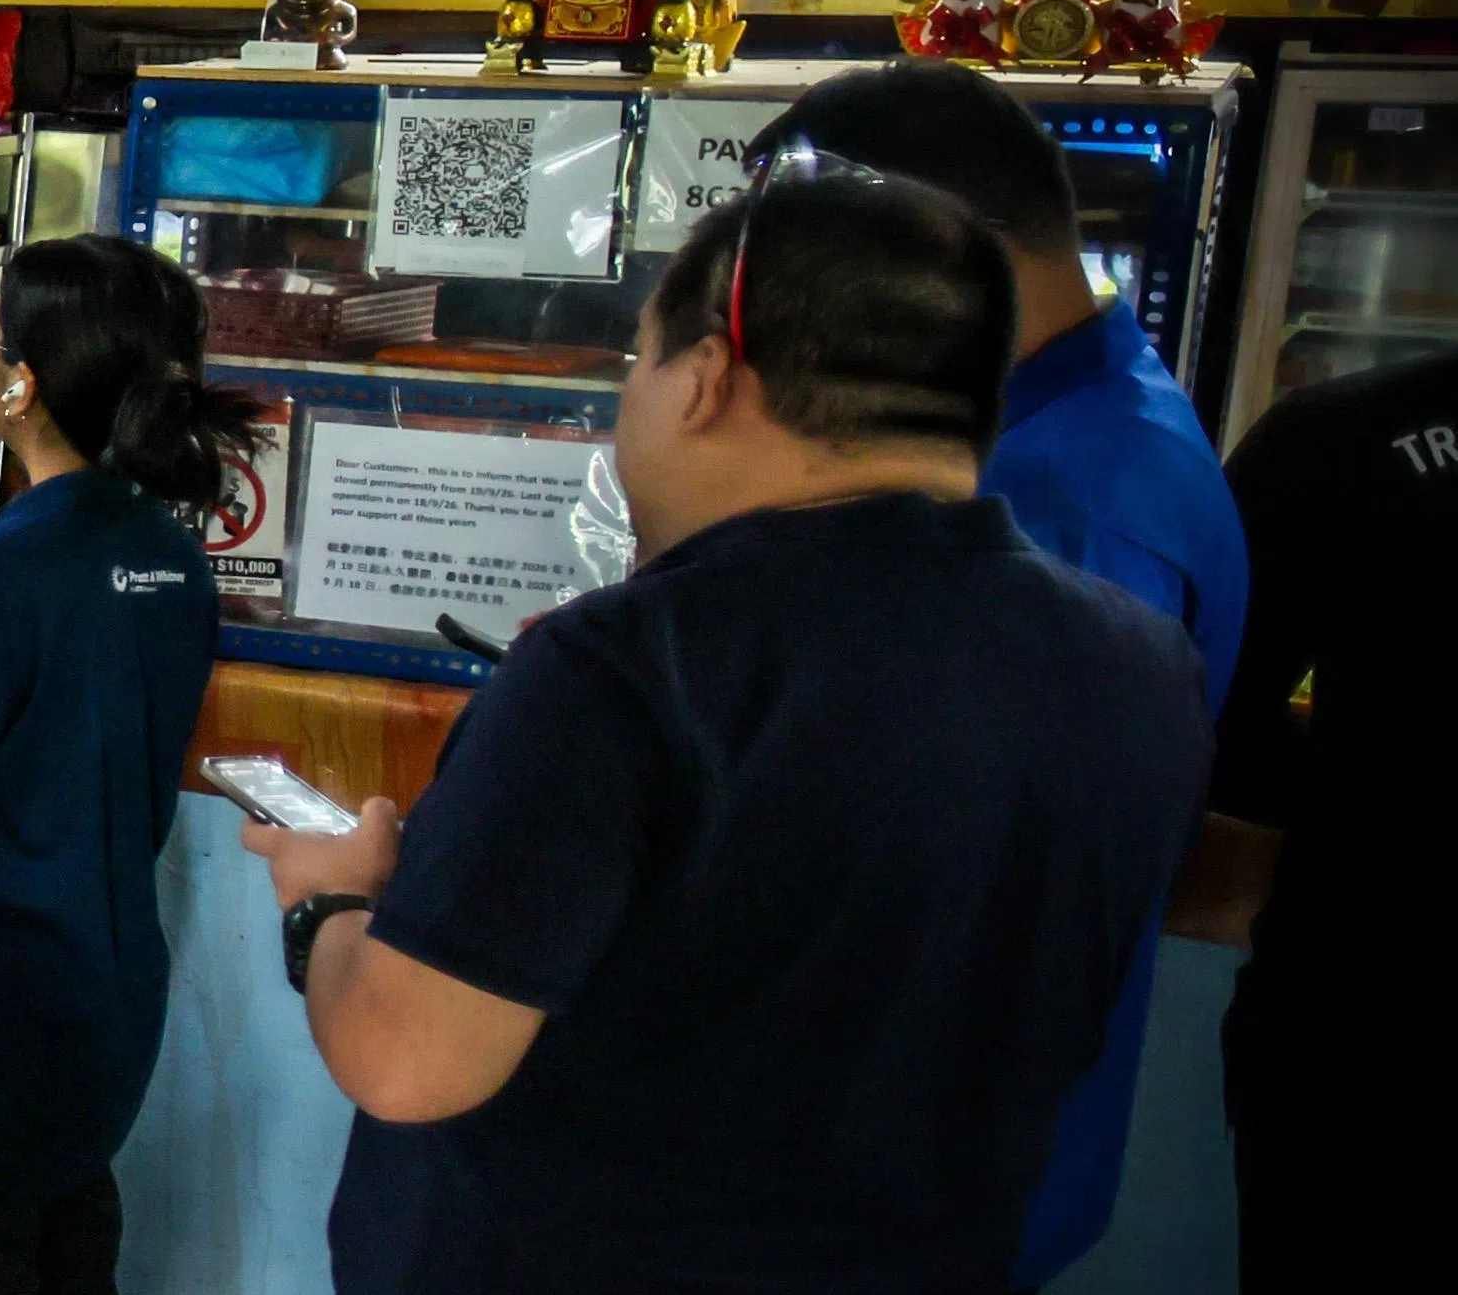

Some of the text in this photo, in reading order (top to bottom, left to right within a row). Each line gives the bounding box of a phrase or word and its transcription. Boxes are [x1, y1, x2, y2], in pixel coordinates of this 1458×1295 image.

[335, 458, 359, 468] Dear
[363, 461, 418, 474] Customers
[427, 467, 448, 477] this
[450, 469, 458, 477] is
[462, 470, 473, 478] to
[516, 474, 537, 484] that
[334, 475, 367, 486] closed
[369, 479, 438, 493] permanently
[440, 483, 467, 494] from
[521, 491, 541, 501] Last
[545, 494, 564, 504] day
[331, 507, 476, 528] your support all these years
[332, 491, 383, 503] operation
[386, 496, 394, 504] is
[464, 502, 495, 513] Thank
[499, 508, 519, 516] you
[522, 507, 537, 517] for
[541, 509, 555, 518] all
[217, 558, 276, 574] $10,000
